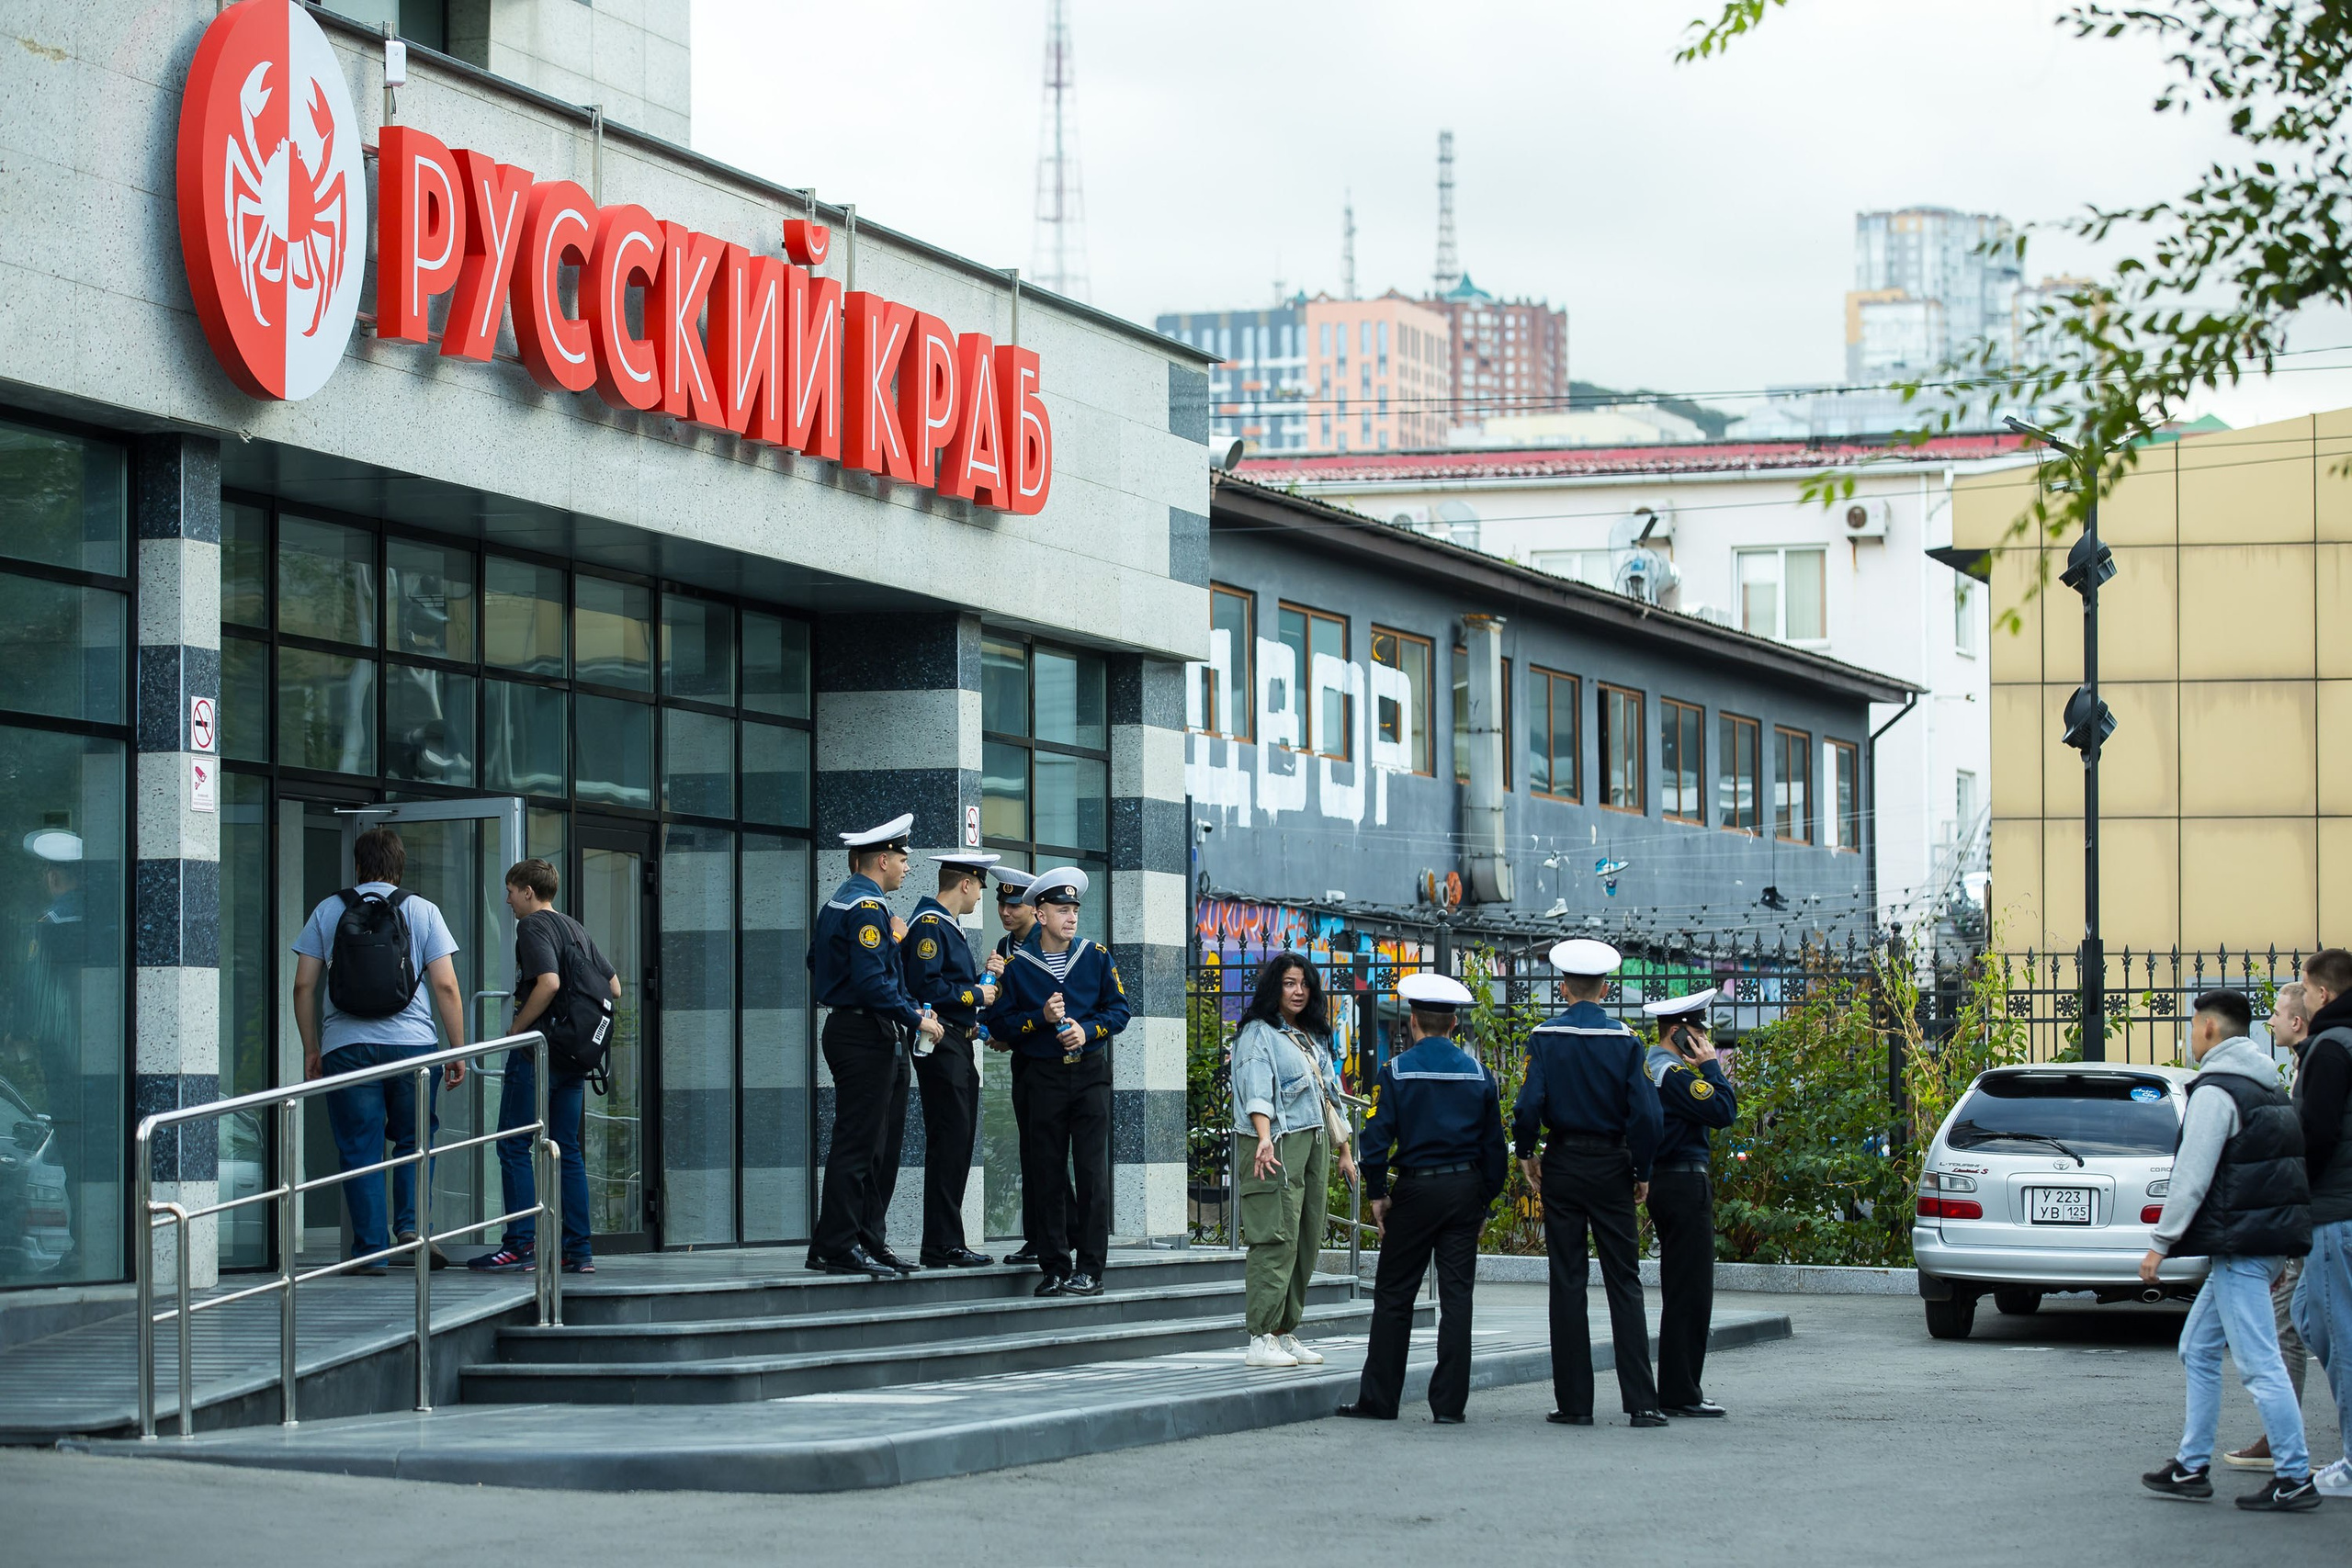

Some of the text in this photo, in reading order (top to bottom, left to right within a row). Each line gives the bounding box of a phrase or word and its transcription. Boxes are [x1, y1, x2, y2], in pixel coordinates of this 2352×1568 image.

[378, 126, 1052, 515] РУССКИЙ КРАБ
[1185, 628, 1413, 827] ДВОР
[2056, 1190, 2081, 1203] 223
[2066, 1206, 2086, 1216] 125
